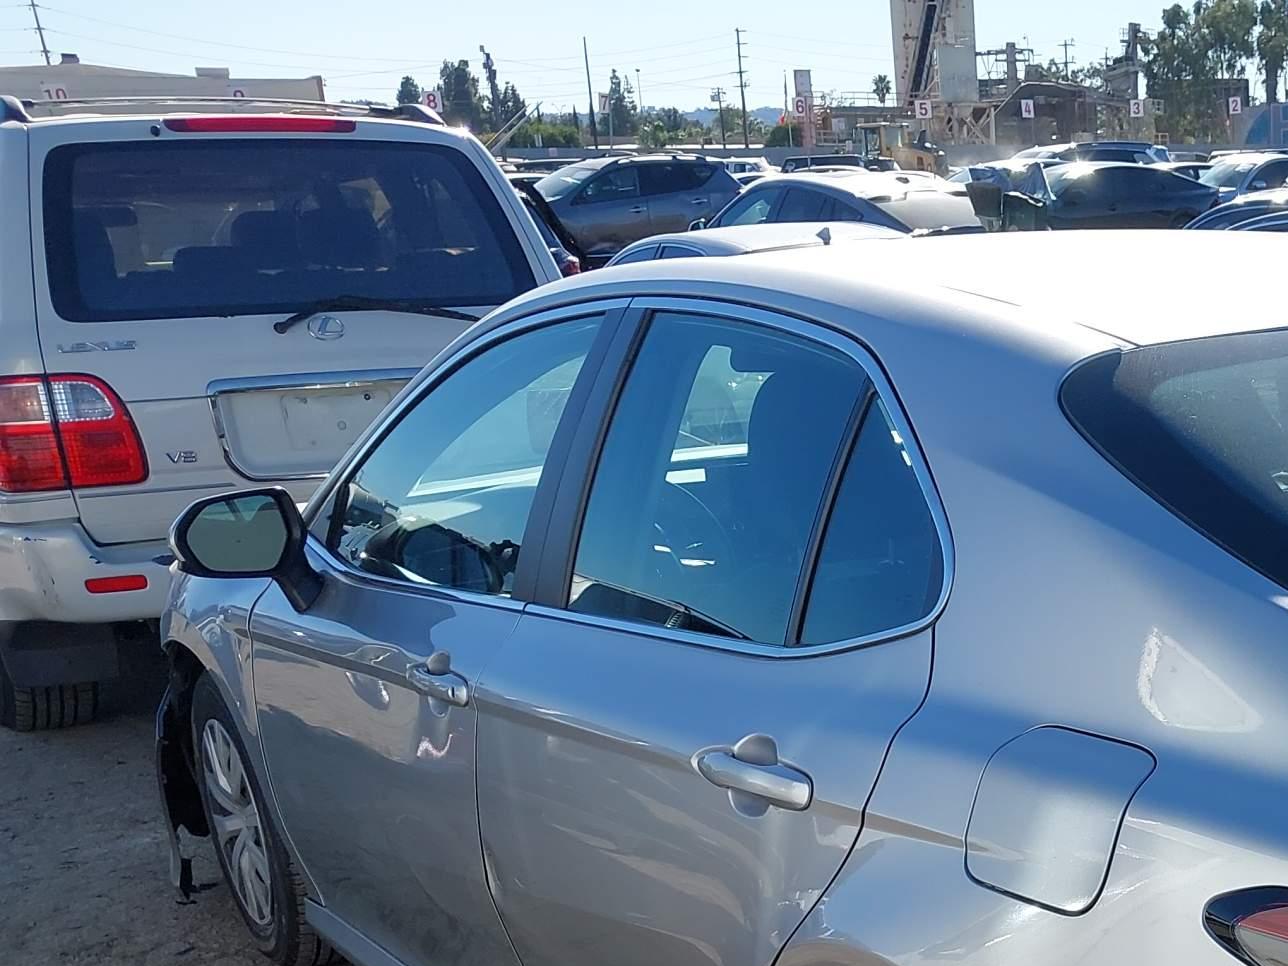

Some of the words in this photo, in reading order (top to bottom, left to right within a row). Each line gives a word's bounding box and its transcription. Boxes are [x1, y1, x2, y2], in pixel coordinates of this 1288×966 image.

[426, 93, 437, 110] 8
[600, 95, 609, 111] 7
[795, 99, 805, 114] 6
[1133, 102, 1141, 115] 3
[1231, 100, 1239, 112] 2
[919, 102, 929, 116] 5
[1024, 102, 1032, 116] 4
[56, 340, 137, 354] LEXUS
